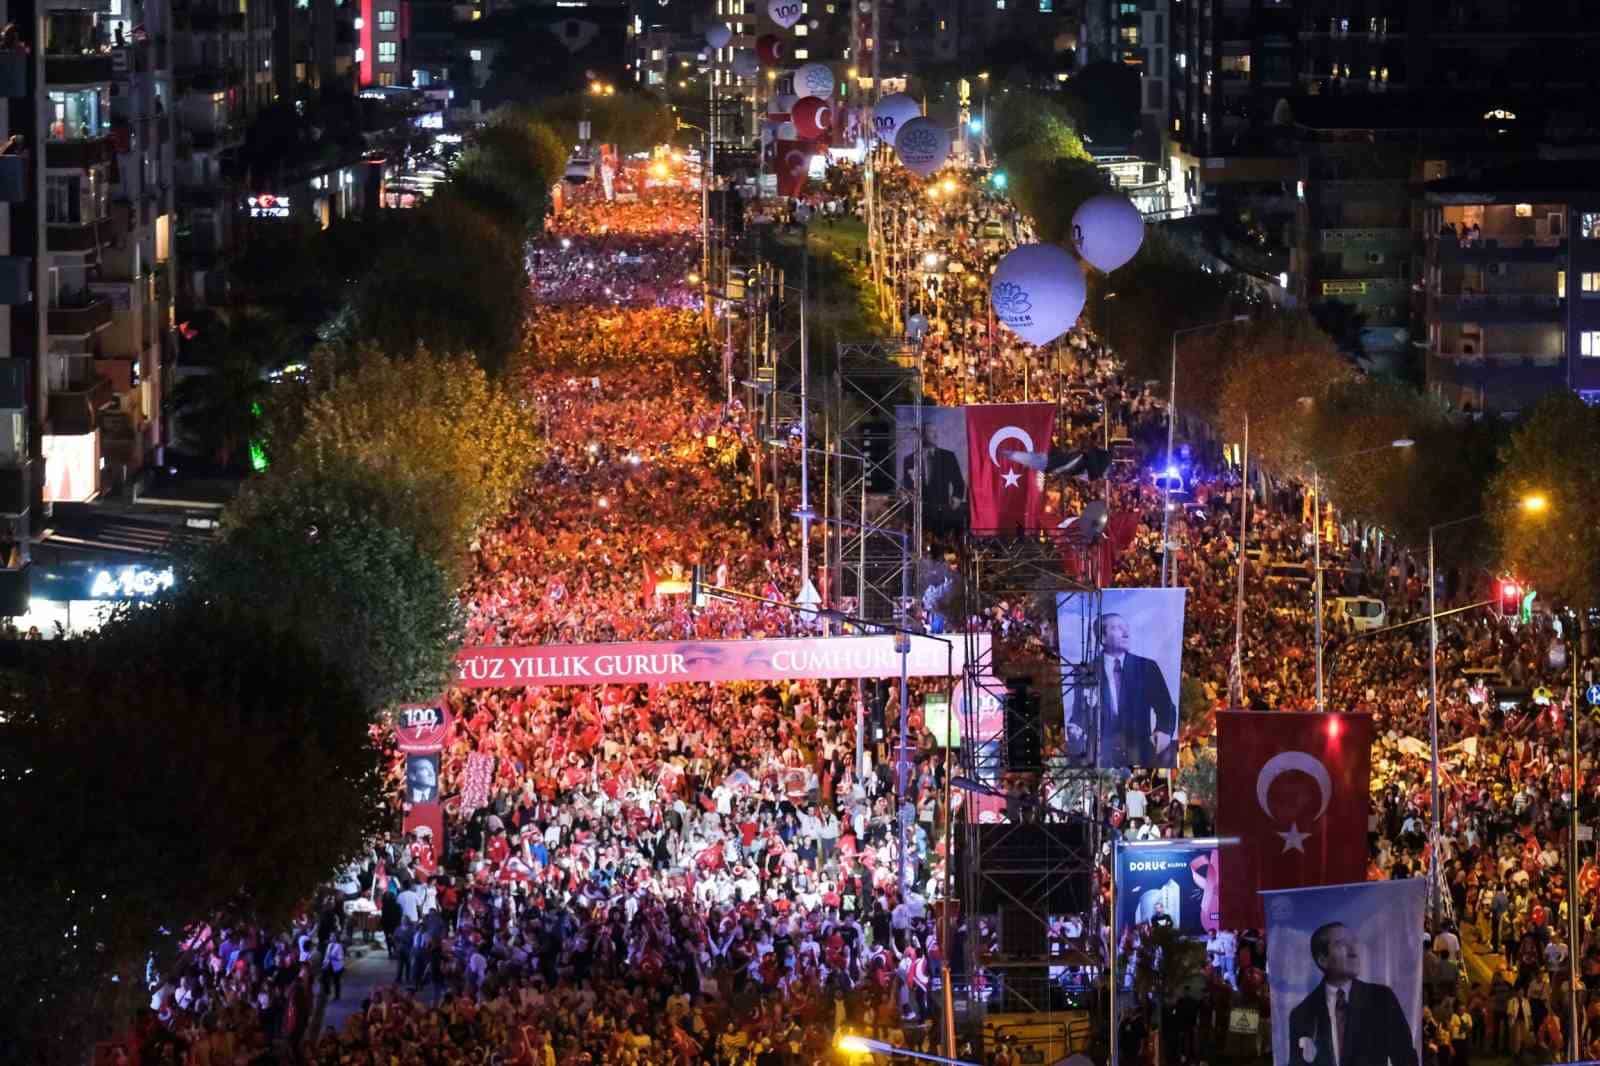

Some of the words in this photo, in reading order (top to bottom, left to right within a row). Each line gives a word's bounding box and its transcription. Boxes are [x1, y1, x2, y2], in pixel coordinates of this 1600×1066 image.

[775, 3, 799, 17] 100
[509, 655, 592, 678] YILLIK
[594, 653, 689, 676] GURUR
